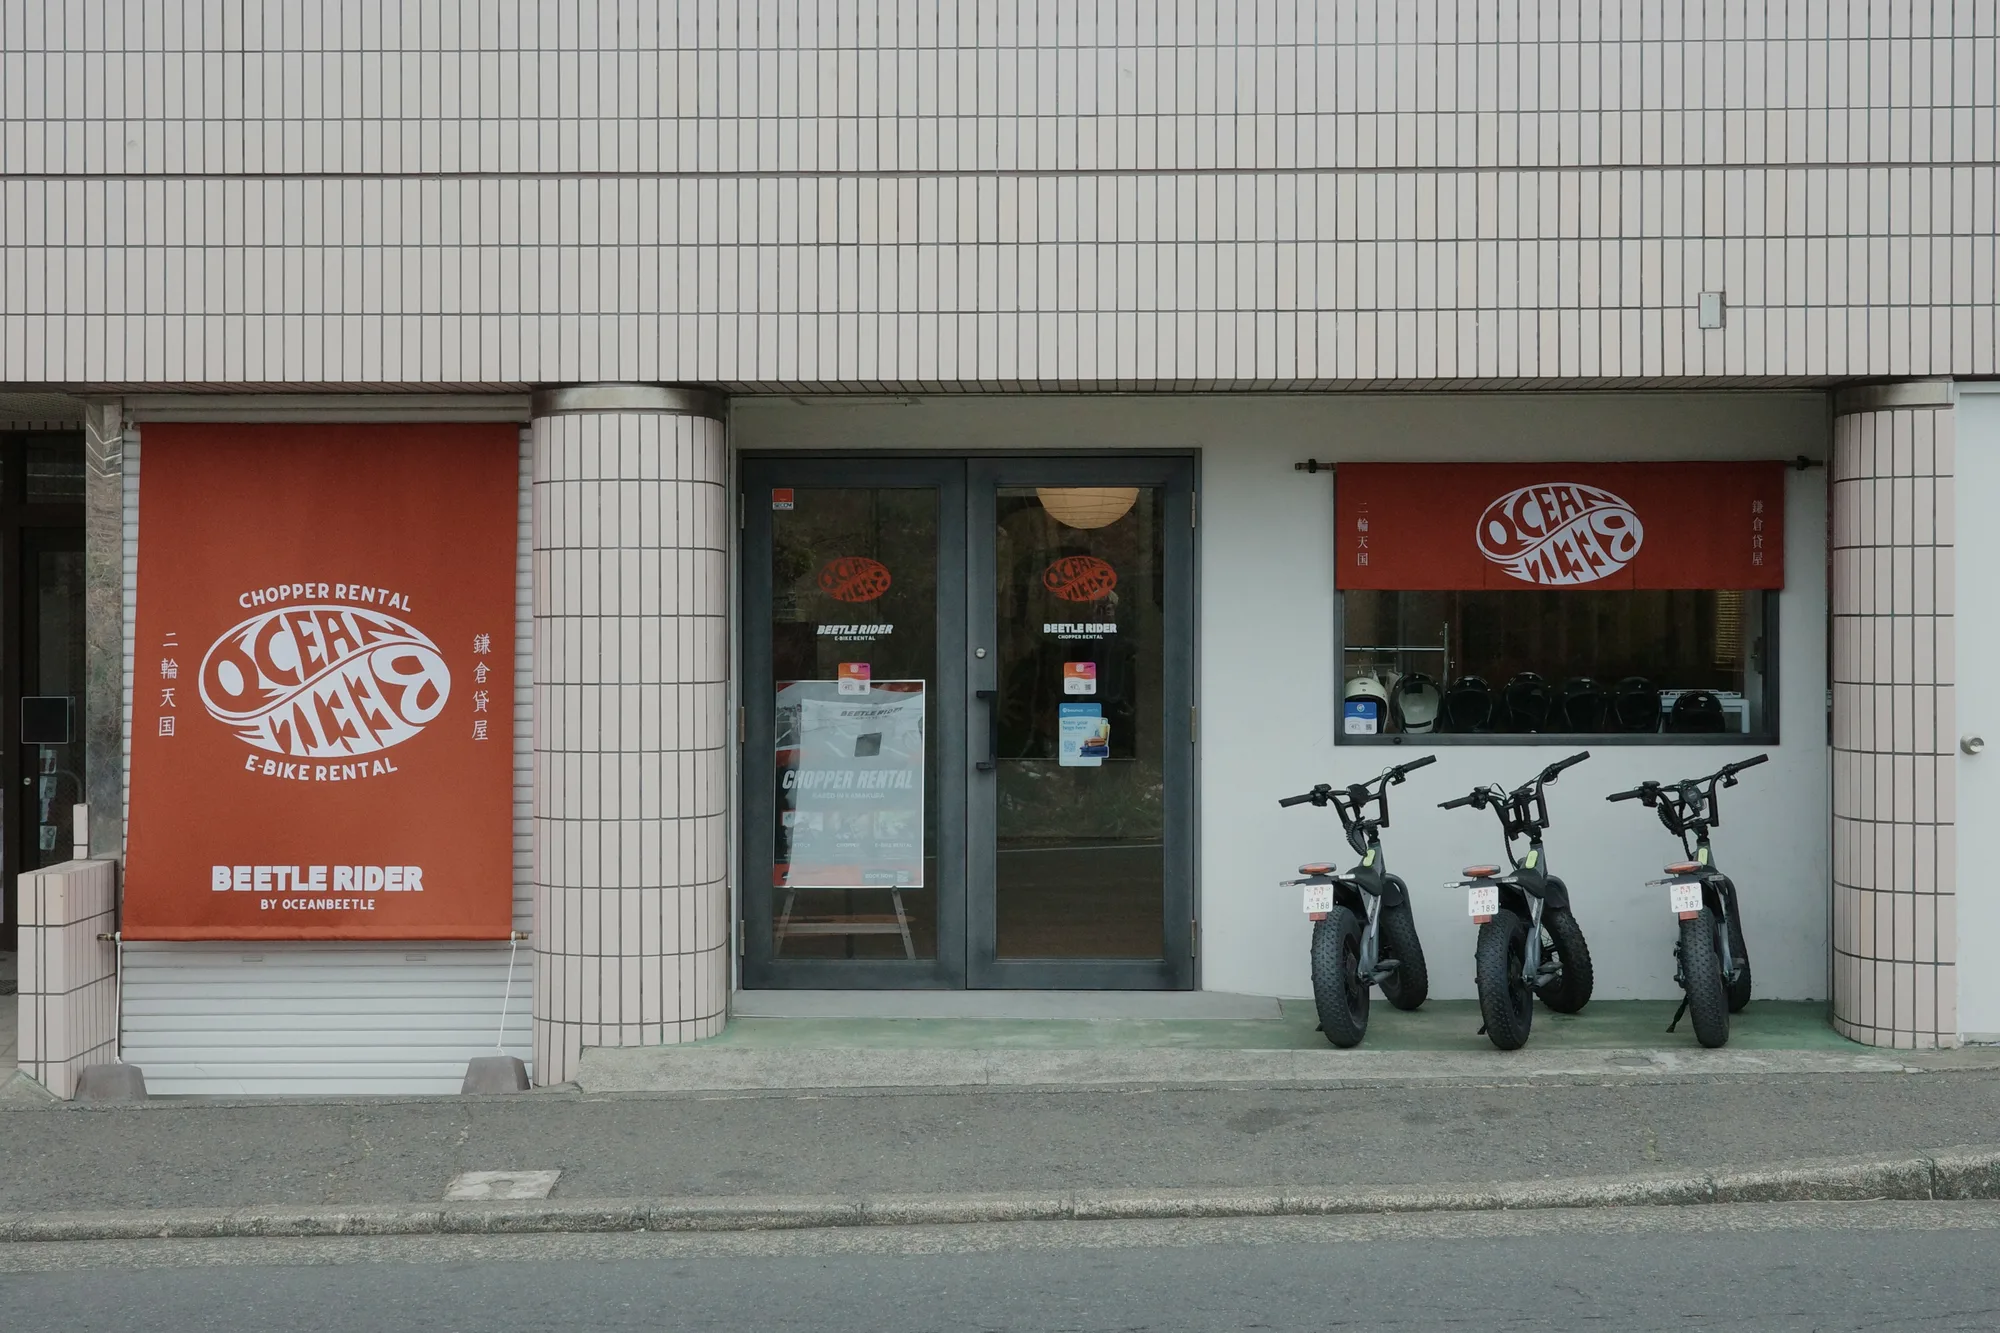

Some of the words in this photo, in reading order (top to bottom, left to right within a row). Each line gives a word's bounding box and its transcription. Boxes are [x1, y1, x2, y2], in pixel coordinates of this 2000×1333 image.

[1480, 485, 1623, 556] OCEAN
[1357, 502, 1369, 566] 二輪天国
[239, 583, 329, 608] CHOPPER
[335, 583, 412, 612] RENTAL
[817, 625, 858, 635] BEETLE
[859, 624, 894, 634] RIDER
[1043, 624, 1084, 633] BEETLE
[1085, 623, 1117, 633] RIDER
[203, 609, 421, 713] OCEAN
[159, 632, 178, 737] 二輪天国
[472, 633, 491, 741] 鎌倉貸屋
[232, 645, 451, 758] BEETLE
[245, 754, 310, 781] E-BIKE
[315, 757, 398, 781] RENTAL
[782, 770, 853, 789] CHOPPER
[857, 770, 913, 789] RENTAL
[212, 865, 327, 891] BEETLE
[333, 866, 423, 891] RIDER
[260, 899, 277, 910] BY
[282, 899, 375, 910] OCEANBEETLE
[1316, 902, 1329, 910] 188
[1481, 904, 1496, 913] 189
[1685, 900, 1699, 908] 187
